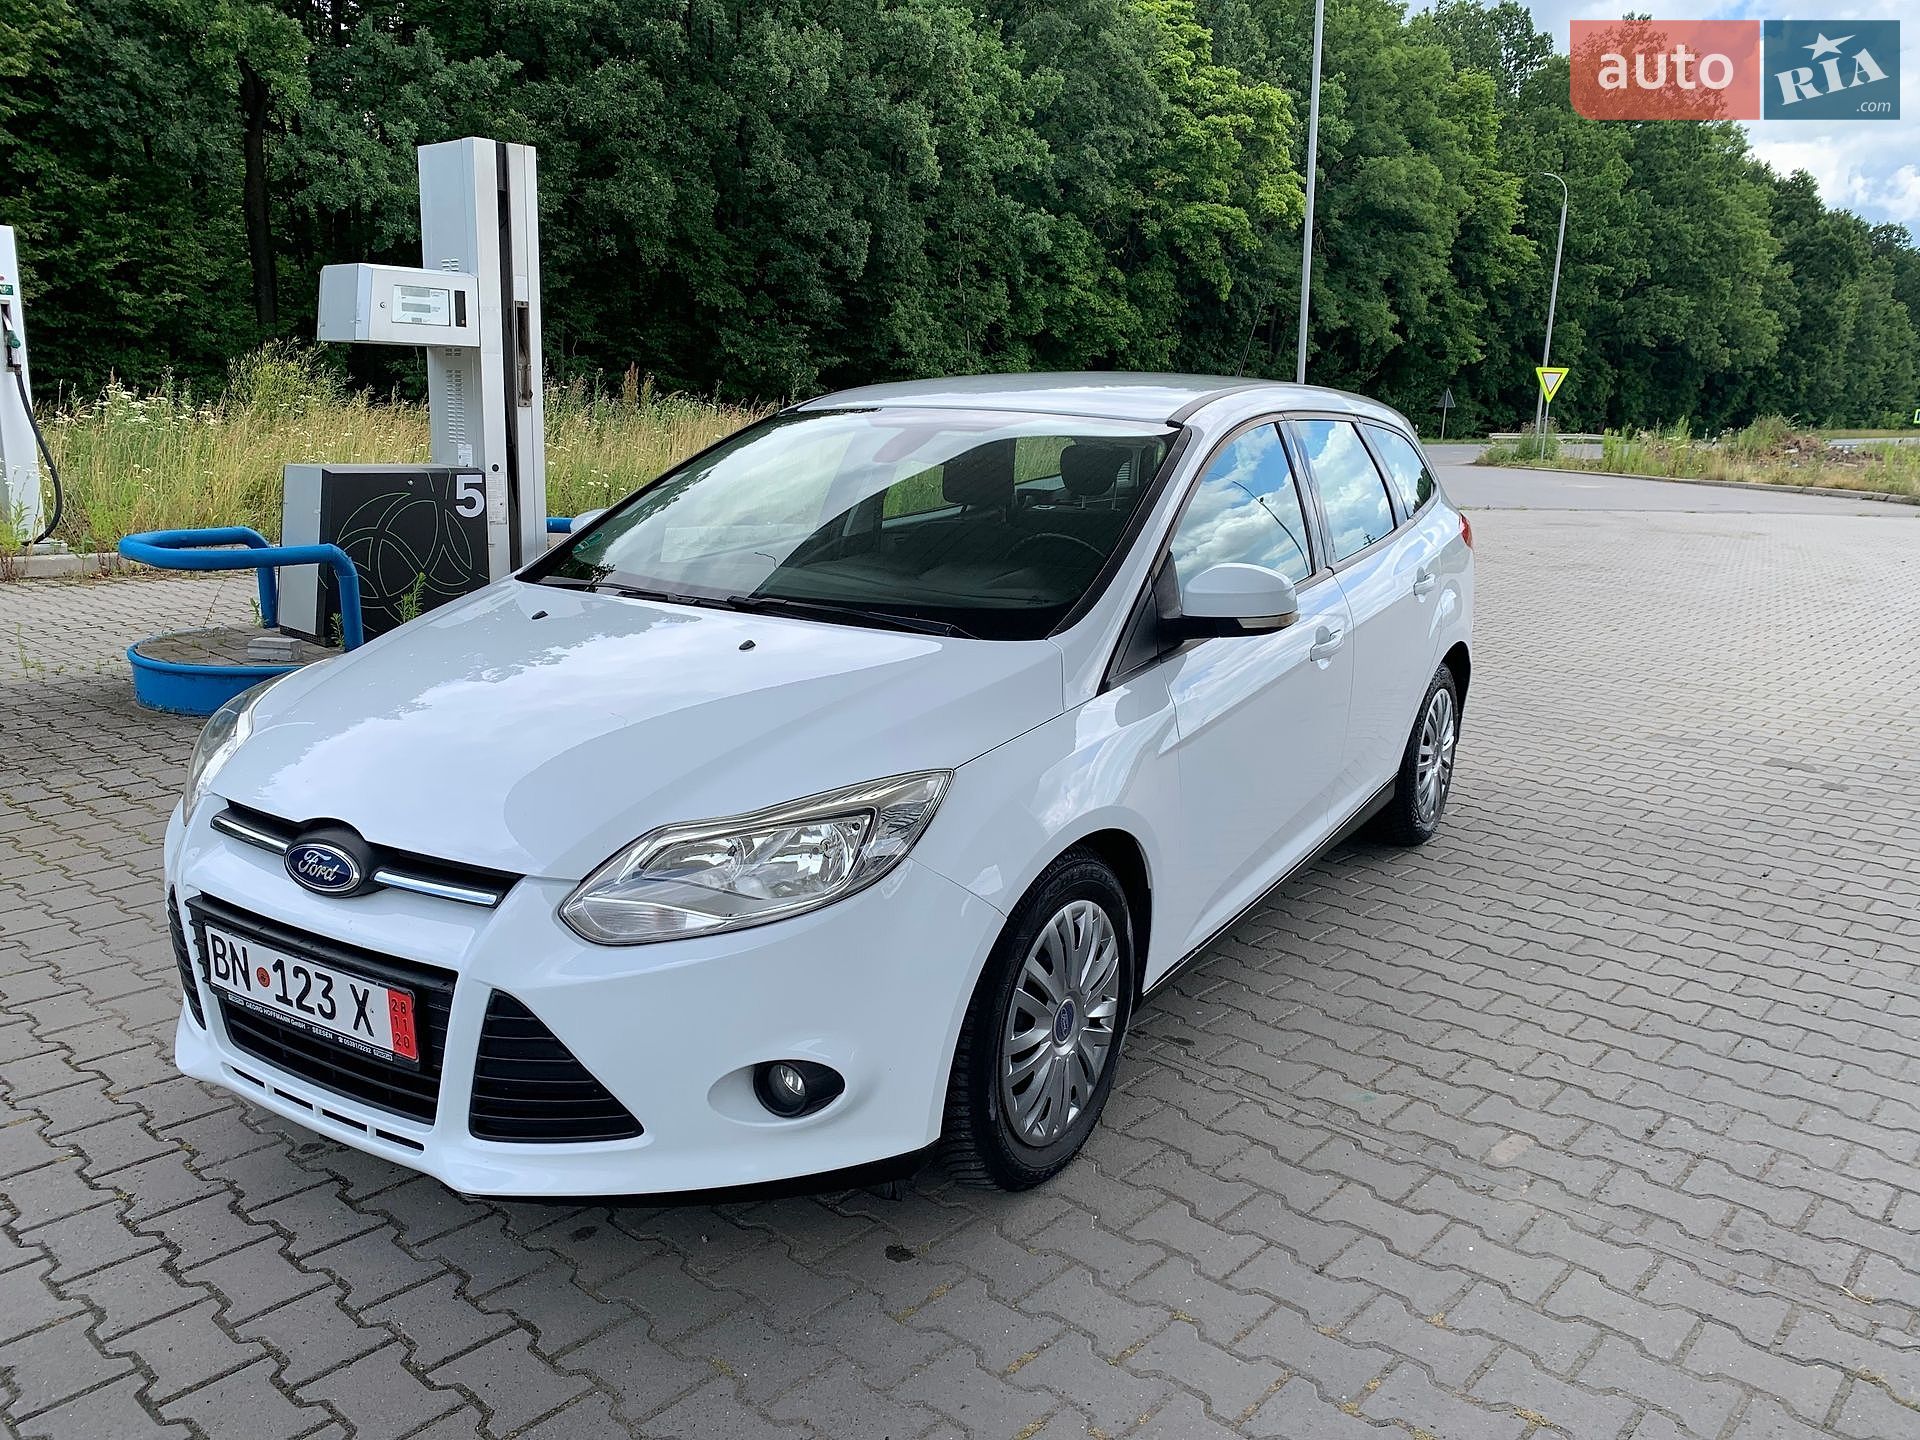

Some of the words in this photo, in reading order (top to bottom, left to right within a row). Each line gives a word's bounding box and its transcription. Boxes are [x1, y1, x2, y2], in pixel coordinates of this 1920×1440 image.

[455, 475, 485, 518] 5
[298, 850, 339, 882] Ford
[211, 934, 251, 992] BN
[272, 959, 336, 1020] 123
[350, 984, 375, 1037] X
[391, 998, 407, 1014] 28
[394, 1014, 409, 1032] 11
[395, 1032, 411, 1049] 20
